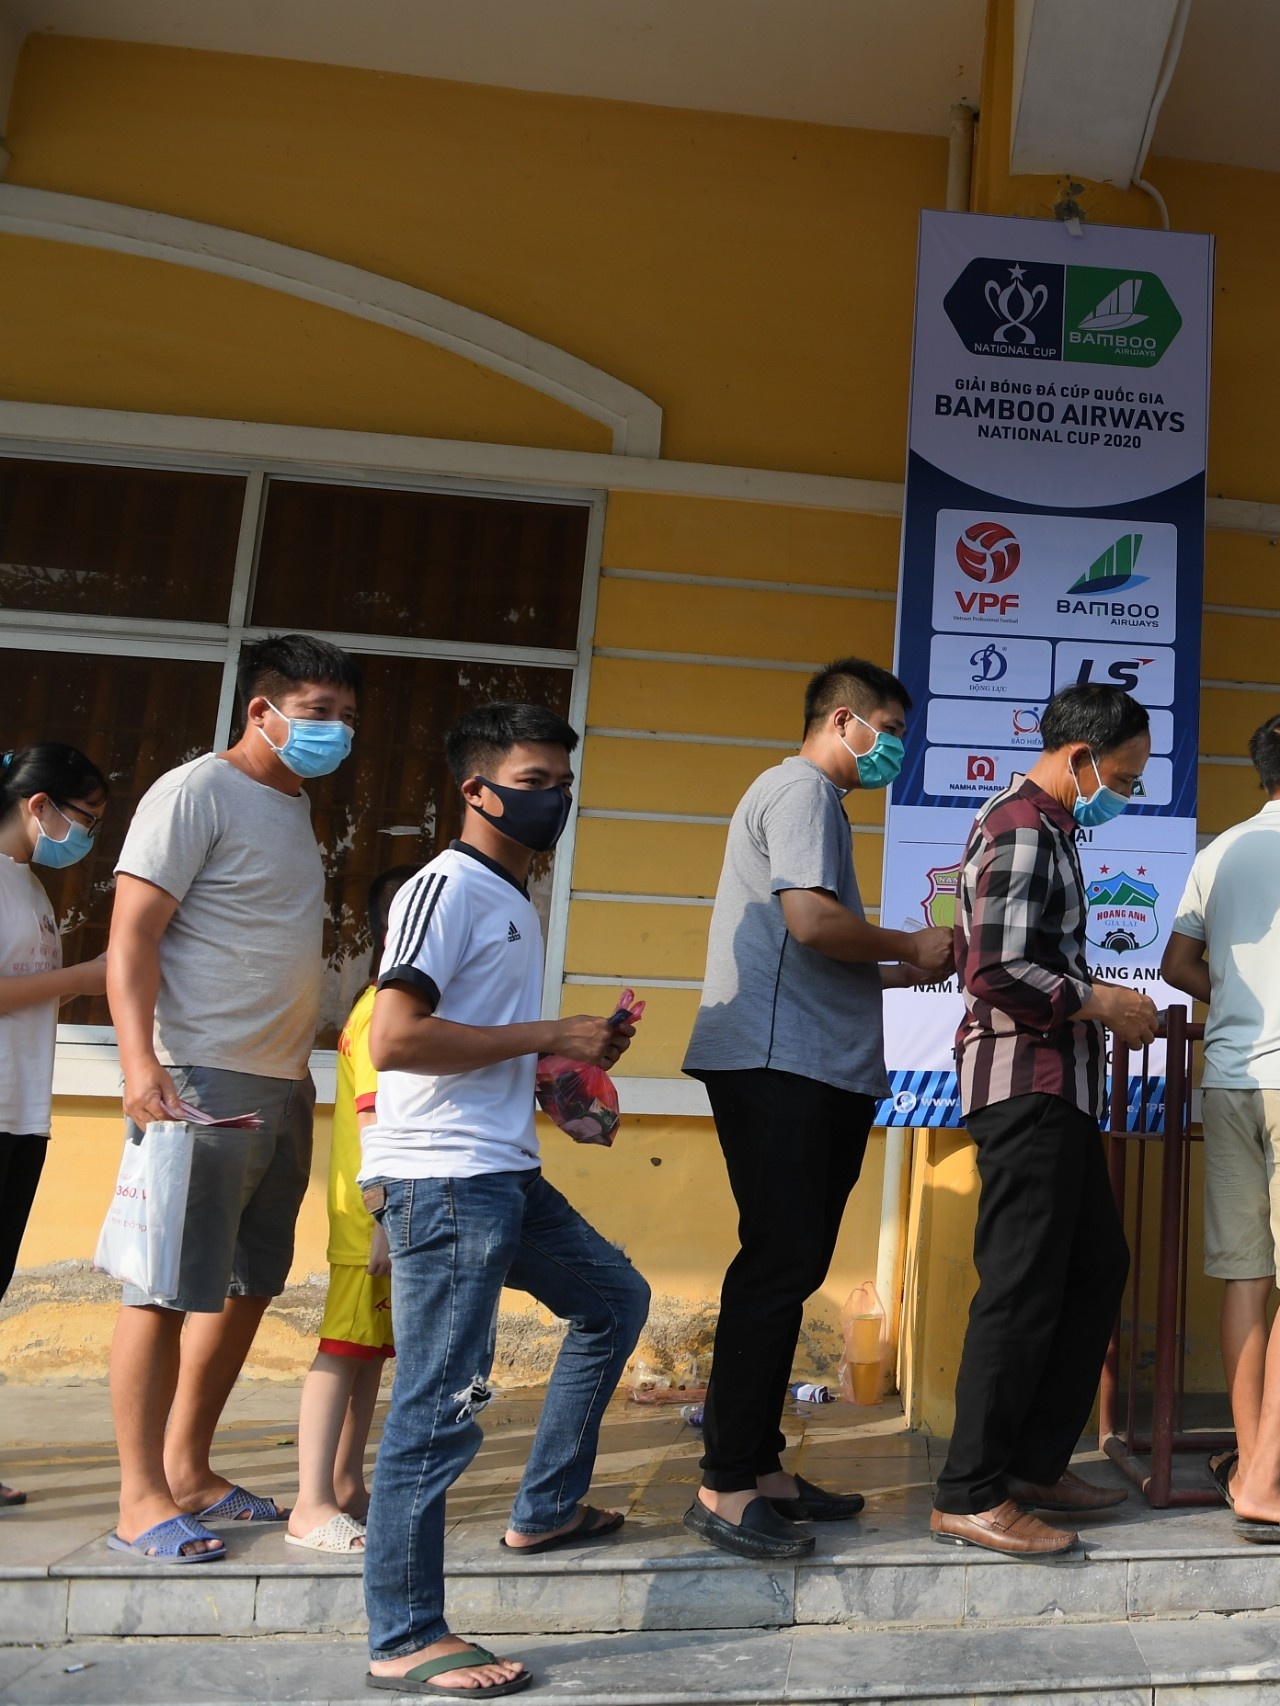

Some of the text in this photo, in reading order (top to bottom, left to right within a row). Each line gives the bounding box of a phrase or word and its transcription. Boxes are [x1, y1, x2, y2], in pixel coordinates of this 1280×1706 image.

[1069, 331, 1157, 350] BAMBOO
[974, 342, 1057, 358] NATIONAL CUP
[1115, 348, 1156, 357] AIRWAYS
[955, 375, 1164, 405] GIẢI BÓNG ĐÁ CÚP QUỐC GIA
[934, 394, 1185, 433] BAMBOO AIRWAYS
[977, 424, 1141, 449] NATIONAL CUP 2020
[954, 591, 1020, 615] VPF
[1057, 600, 1159, 618] BAMBOO
[1111, 618, 1159, 628] AIRWAYS
[1128, 912, 1146, 922] ANH
